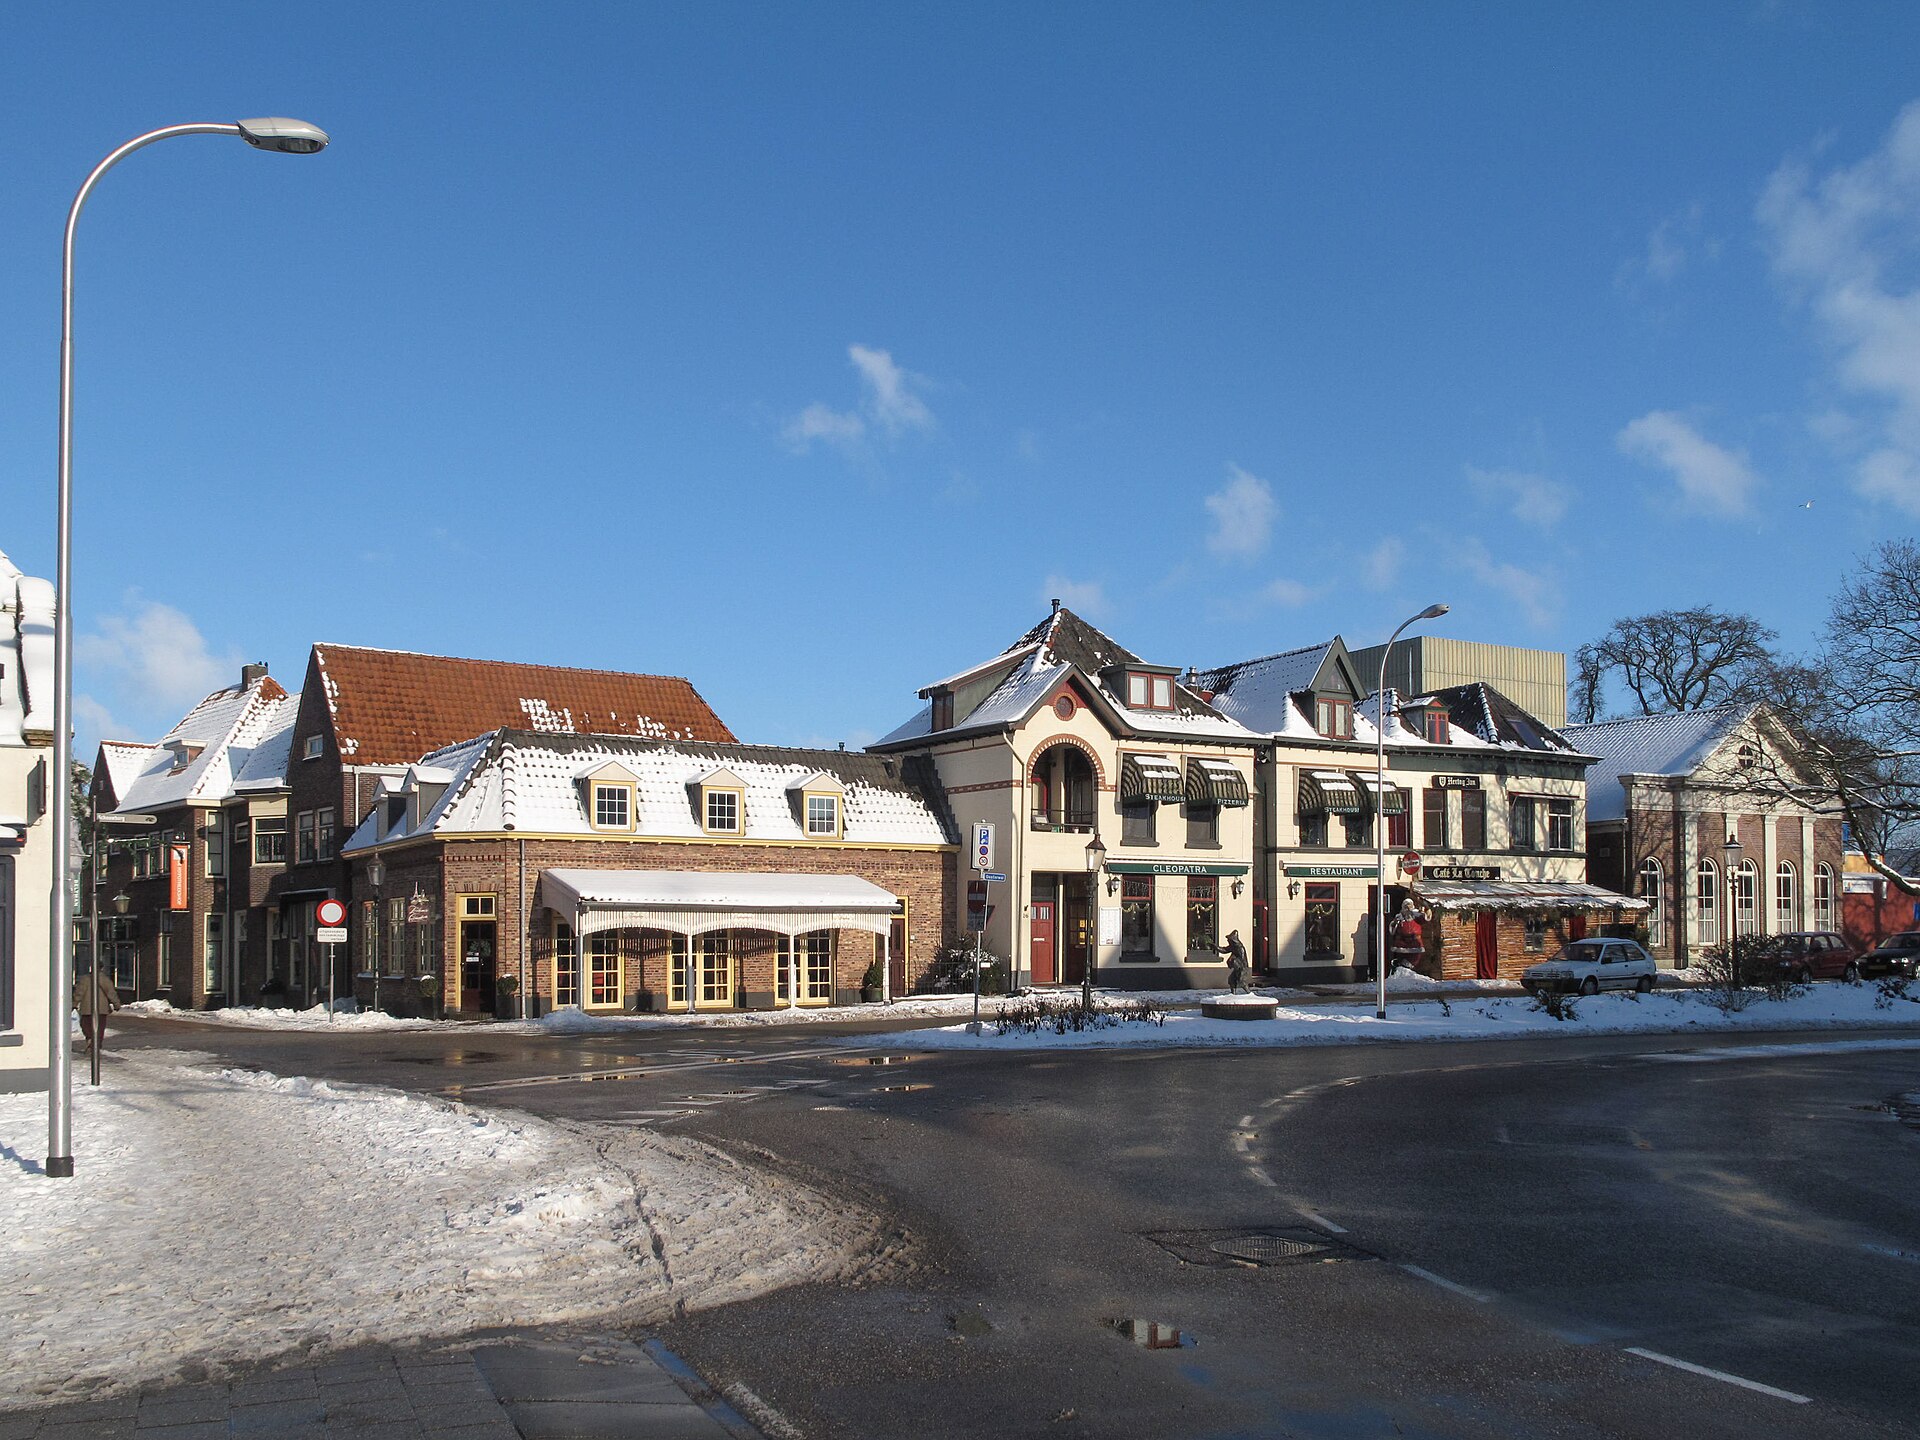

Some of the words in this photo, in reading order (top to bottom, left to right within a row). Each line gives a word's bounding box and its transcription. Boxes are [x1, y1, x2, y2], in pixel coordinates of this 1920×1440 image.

[1217, 798, 1246, 806] PIZZERIA
[1152, 864, 1207, 873] CLEOPATRA
[1310, 867, 1363, 875] RESTAURANT
[1433, 867, 1451, 878] Café
